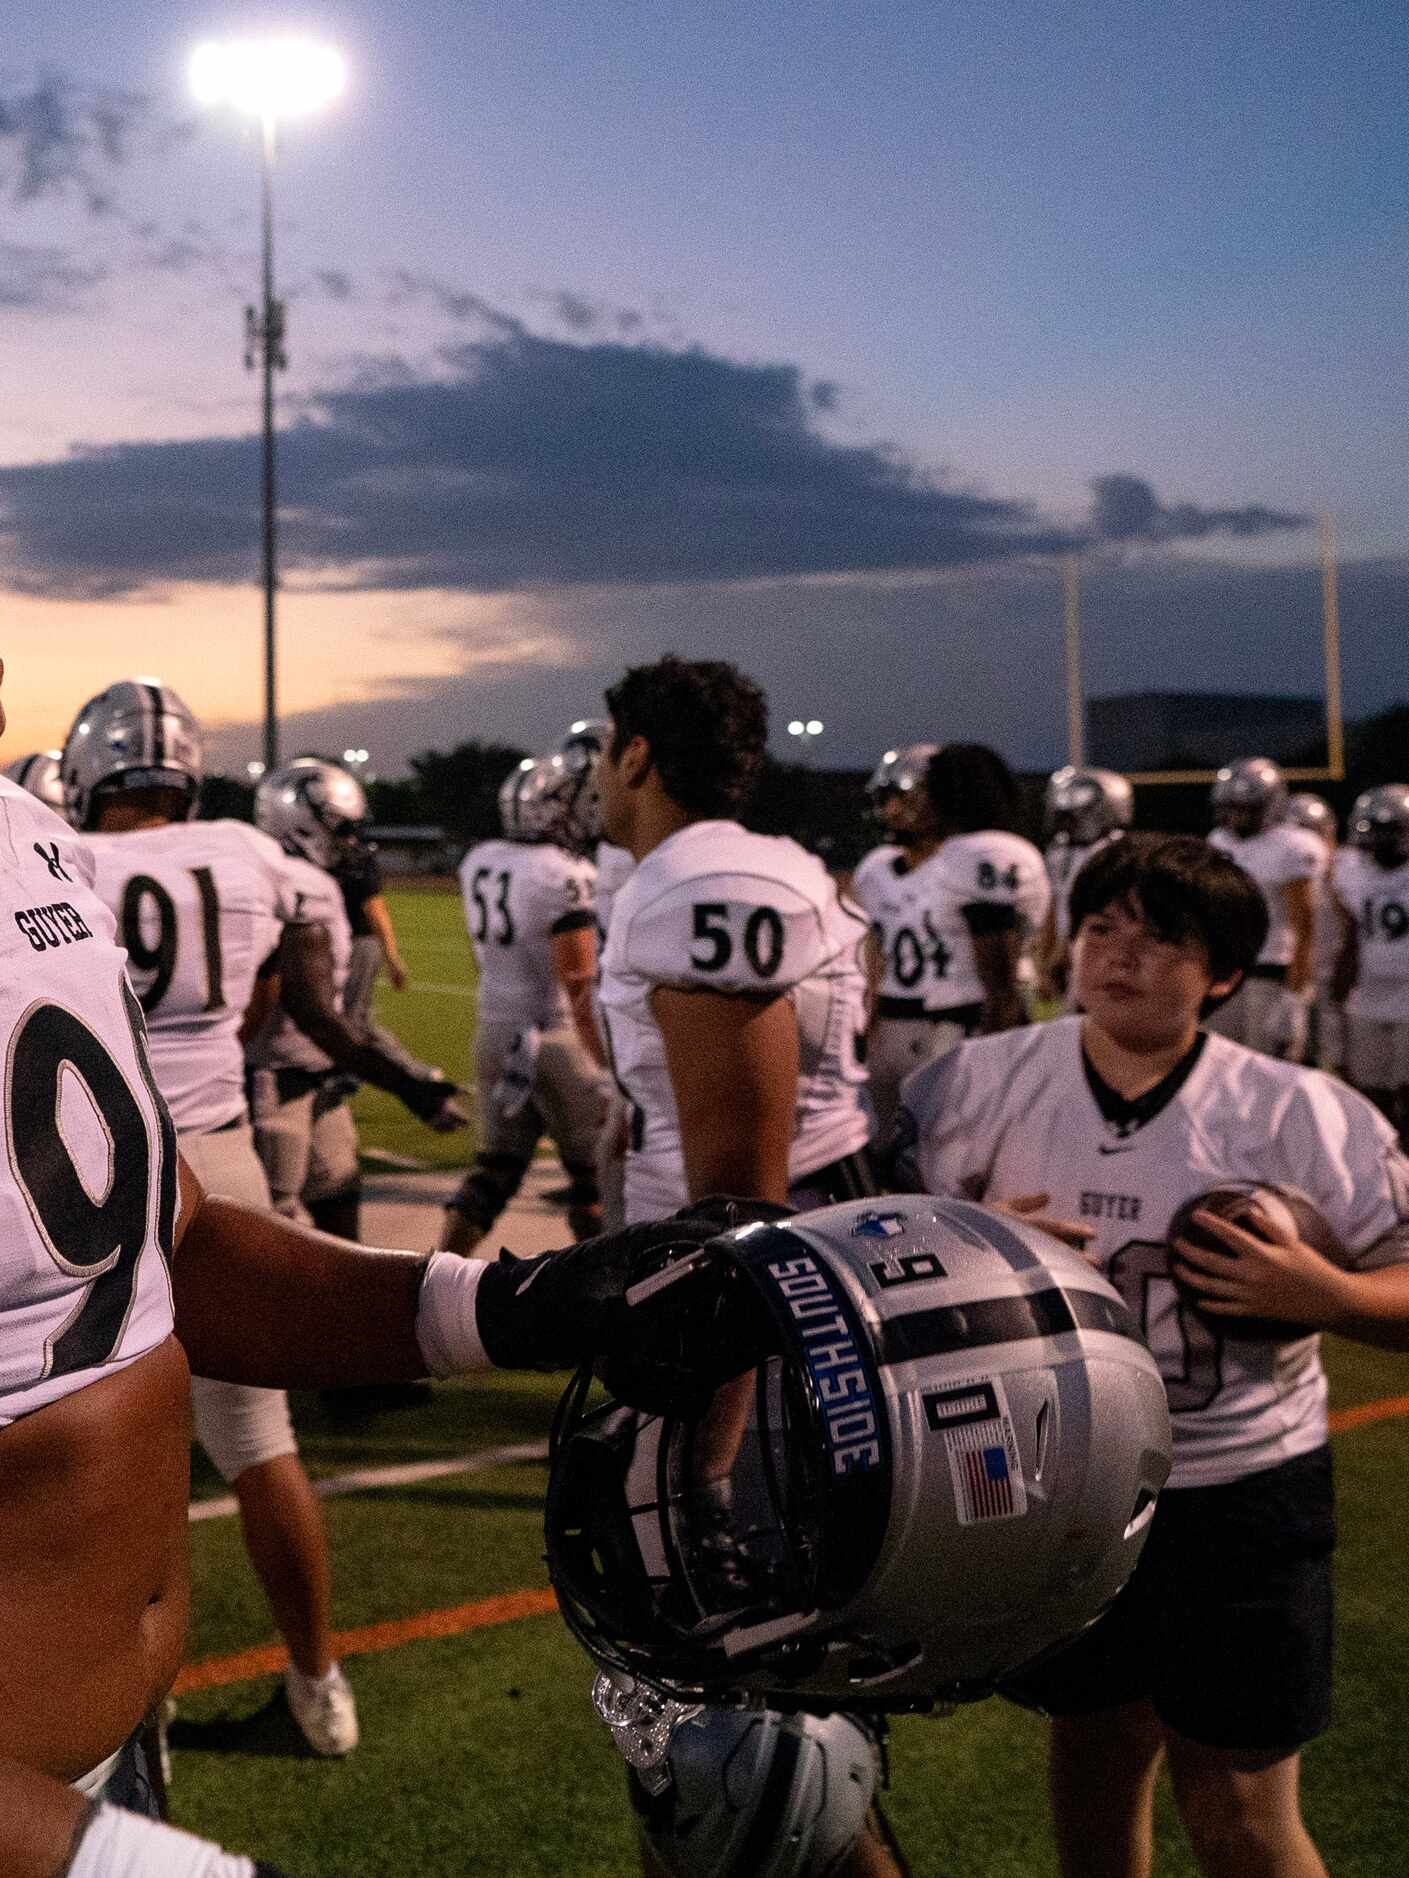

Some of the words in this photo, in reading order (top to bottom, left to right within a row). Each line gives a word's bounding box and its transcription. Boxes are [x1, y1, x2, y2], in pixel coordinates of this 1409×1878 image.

[14, 902, 94, 952] GUYER
[122, 866, 227, 1017] 91
[691, 903, 785, 978] 50
[1080, 1190, 1141, 1222] GUYER
[767, 1255, 881, 1475] SOUTHSIDE
